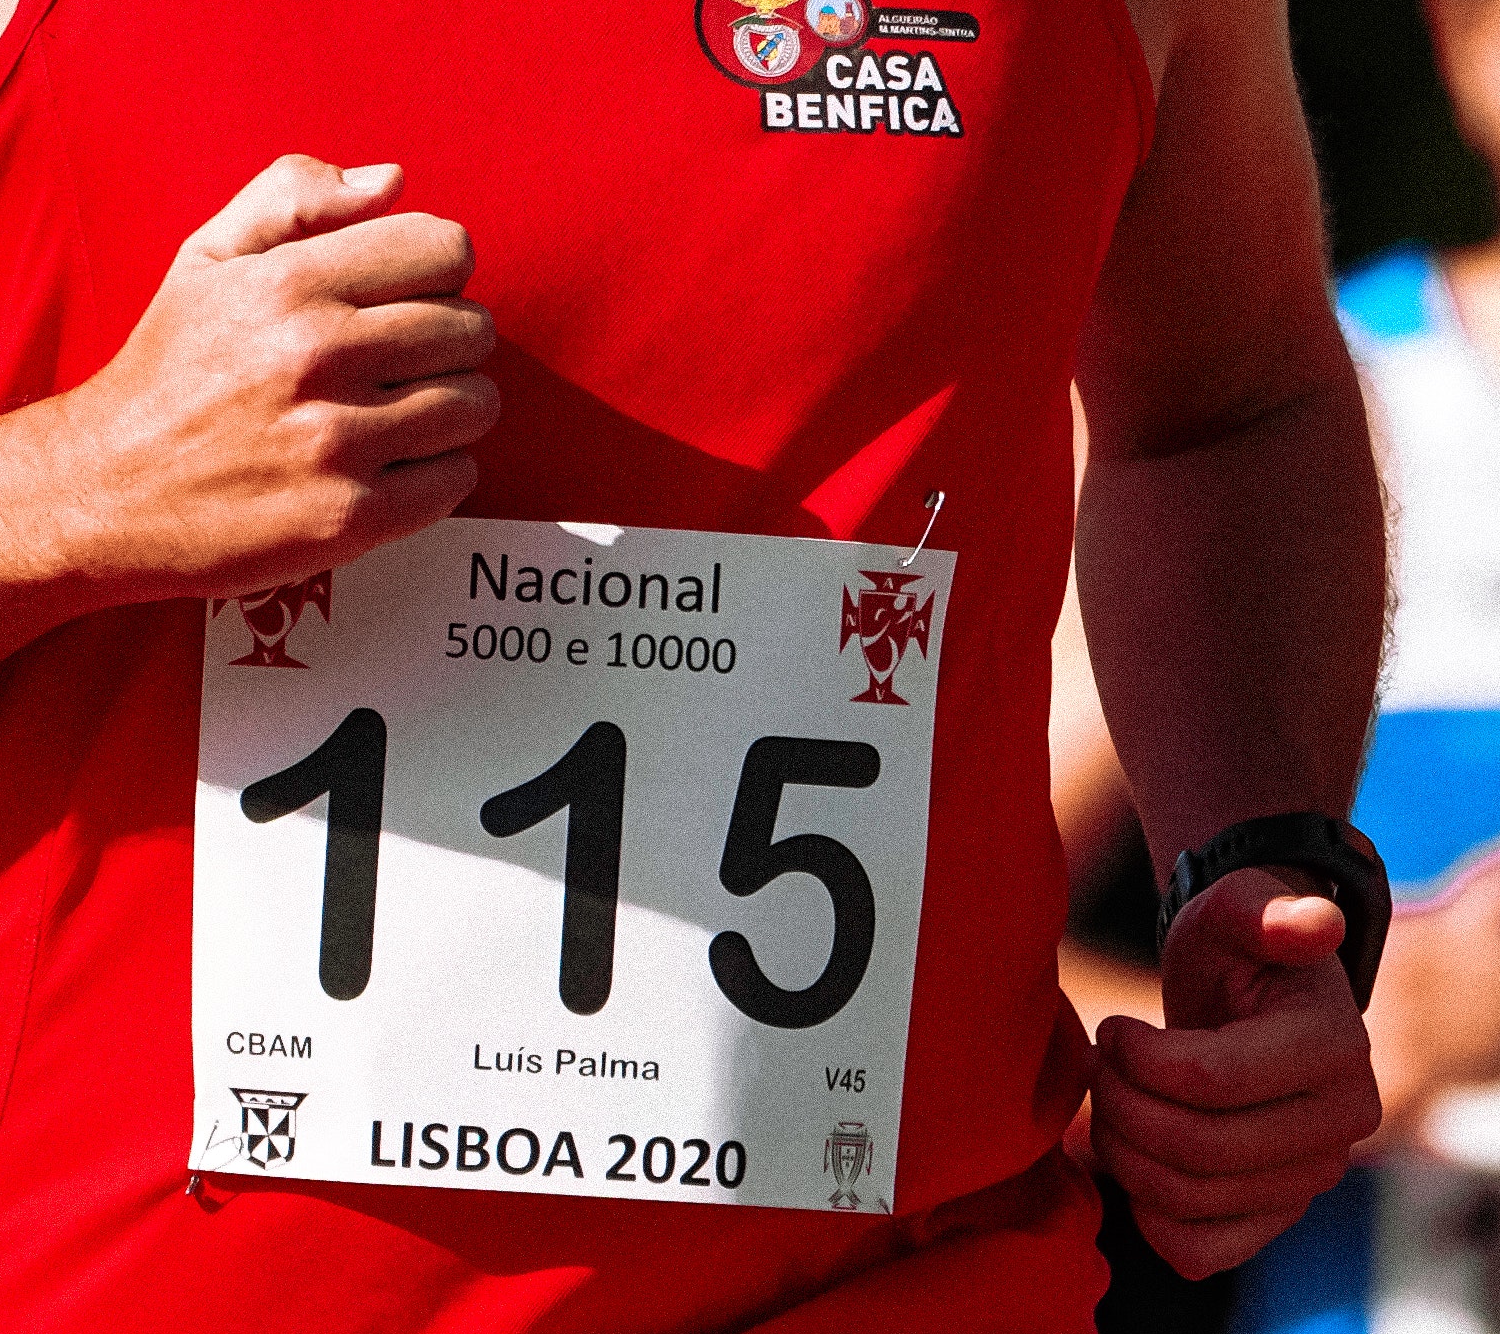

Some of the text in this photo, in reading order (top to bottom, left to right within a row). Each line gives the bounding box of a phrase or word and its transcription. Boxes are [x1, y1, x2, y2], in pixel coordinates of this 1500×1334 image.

[826, 55, 943, 92] CASA
[765, 92, 960, 133] BENFICA
[467, 550, 722, 614] Nacional
[445, 621, 738, 675] 5000 e 10000
[239, 706, 882, 1031] 115
[225, 1030, 313, 1060] CBAM
[473, 1043, 661, 1082] Luís Palma
[824, 1066, 868, 1094] V45
[370, 1120, 748, 1190] LISBOA 2020
